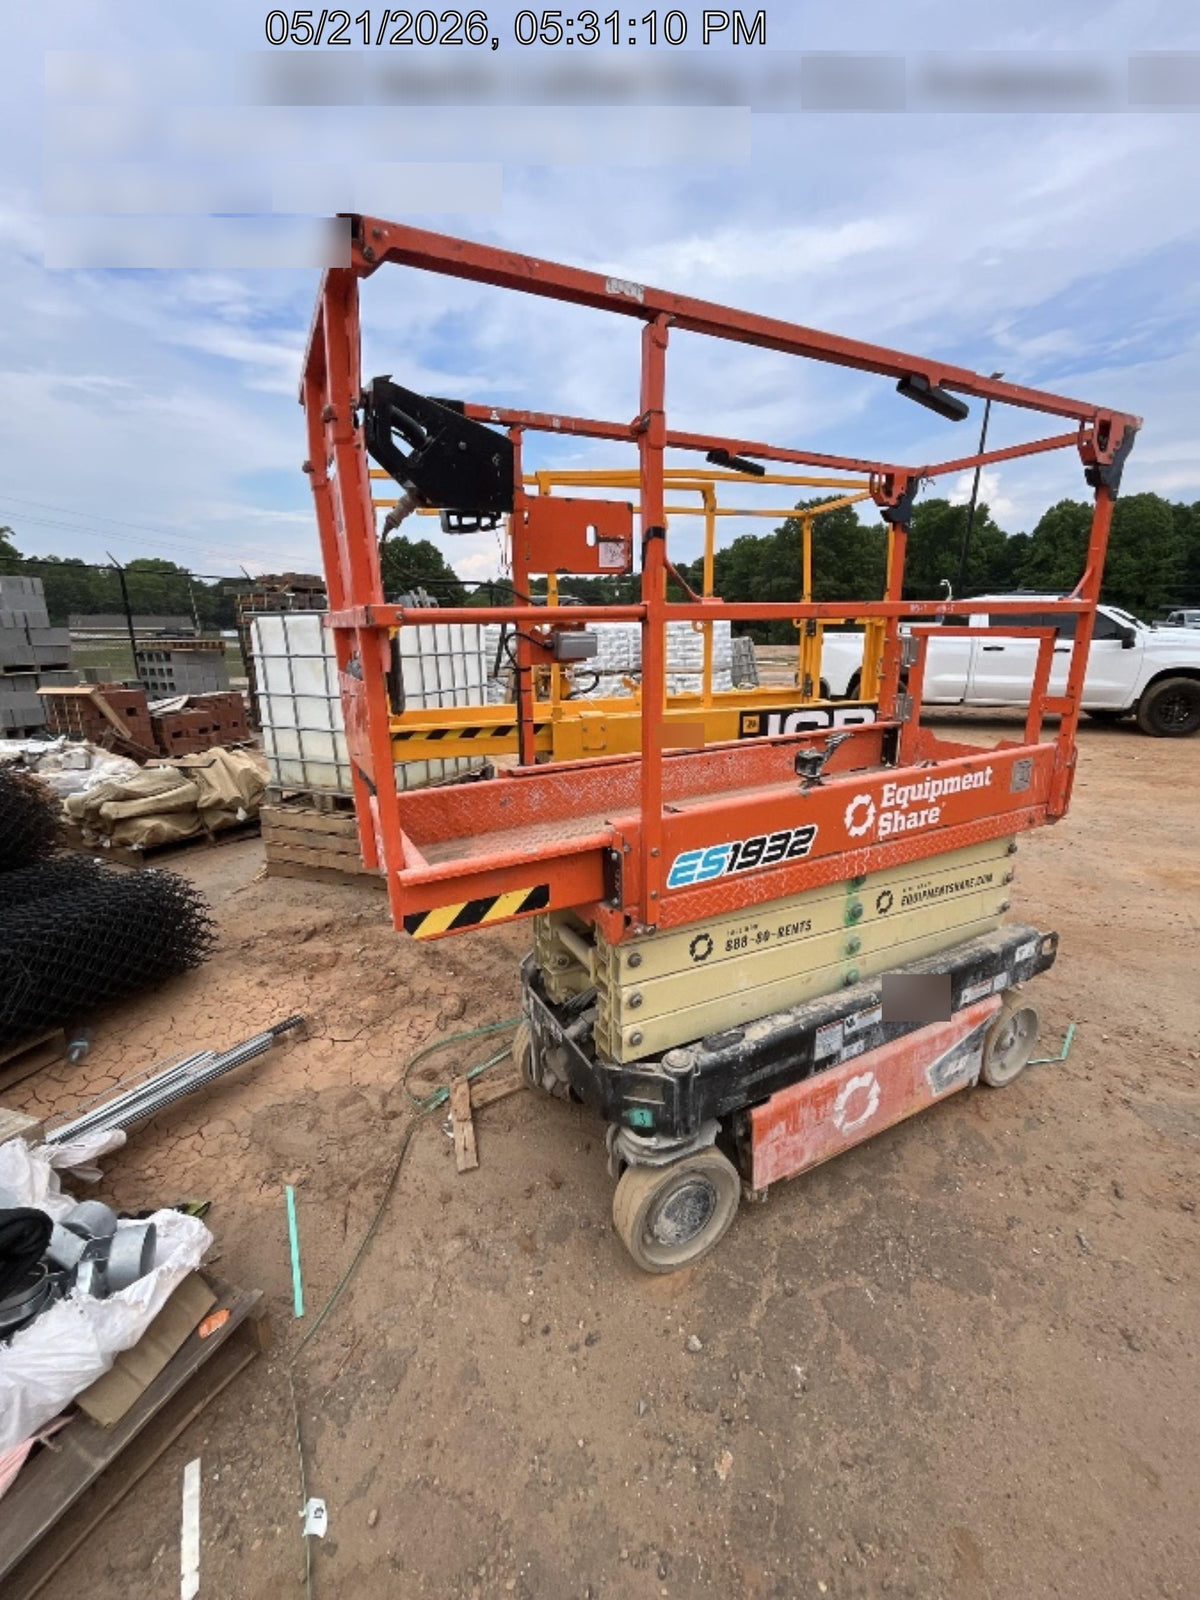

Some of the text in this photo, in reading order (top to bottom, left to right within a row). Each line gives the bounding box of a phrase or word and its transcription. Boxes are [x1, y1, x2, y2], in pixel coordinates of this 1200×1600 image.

[881, 766, 993, 809] Equipment
[878, 806, 941, 838] Share
[667, 824, 818, 889] ES1932
